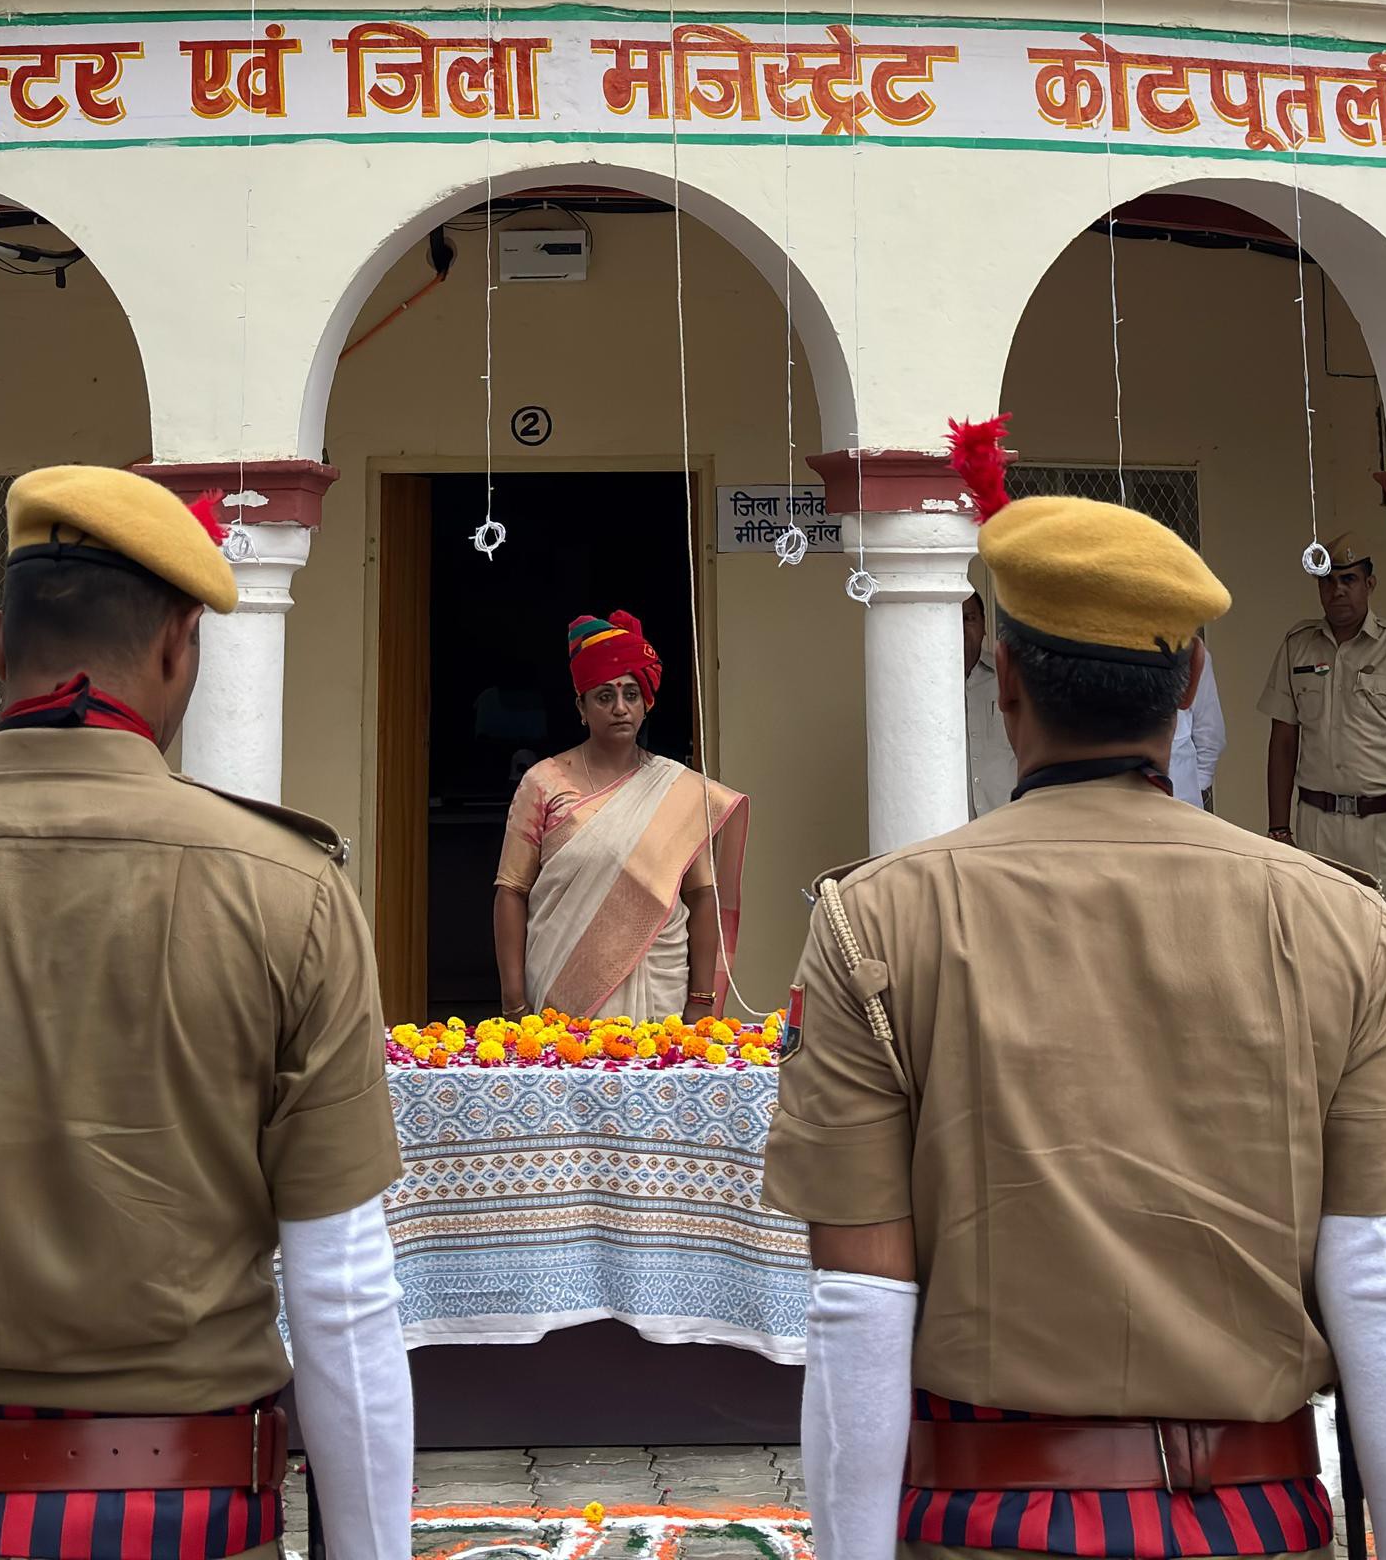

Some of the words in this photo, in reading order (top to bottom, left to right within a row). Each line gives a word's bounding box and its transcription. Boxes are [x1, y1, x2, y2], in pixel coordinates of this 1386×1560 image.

[179, 23, 303, 120] एवं
[331, 21, 553, 120] जिला
[590, 23, 960, 137] मजिस्ट्रेट
[729, 490, 780, 517] जिला
[804, 519, 842, 546] हॉल
